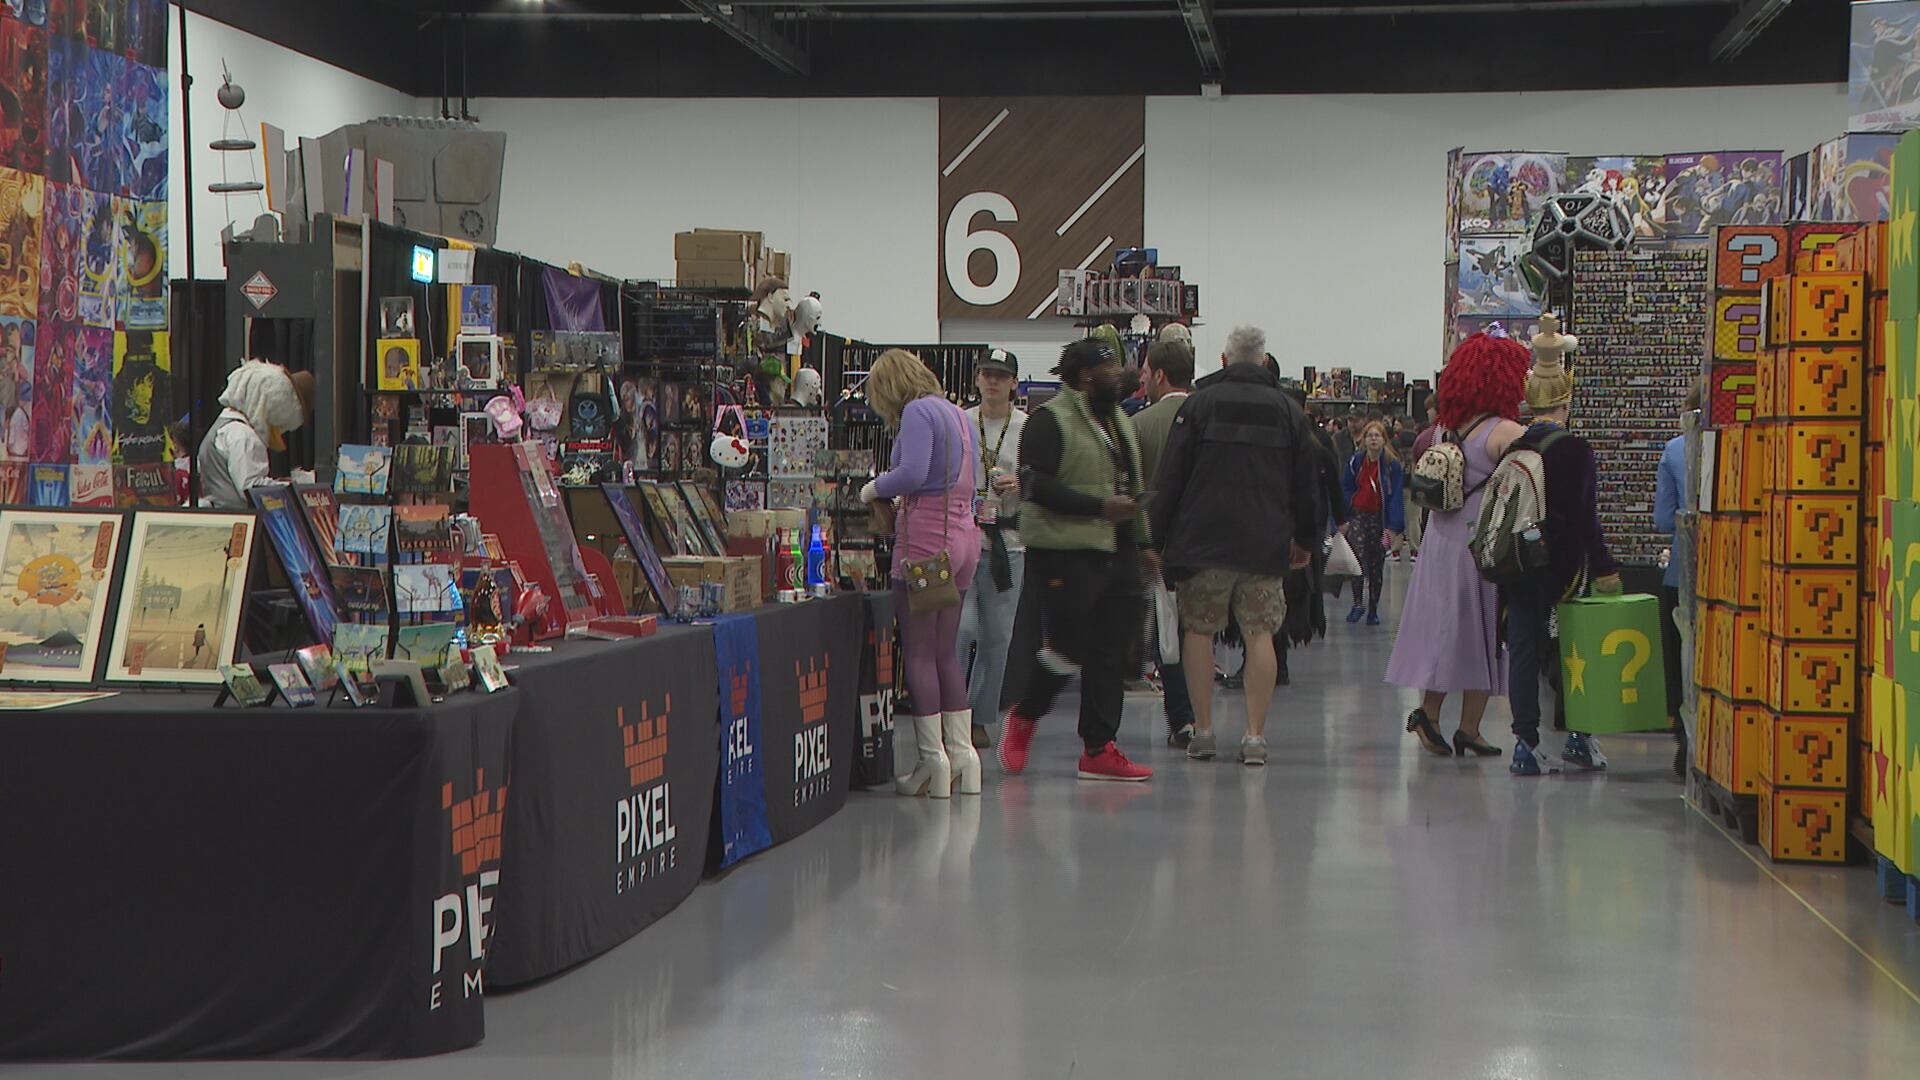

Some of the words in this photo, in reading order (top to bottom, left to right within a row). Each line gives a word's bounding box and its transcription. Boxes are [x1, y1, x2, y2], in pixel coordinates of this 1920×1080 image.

[944, 190, 1022, 305] 6
[794, 722, 831, 783] PIXEL
[793, 774, 831, 808] EMPIRE
[616, 782, 676, 864] PIXEL
[616, 846, 677, 895] EMPIRE
